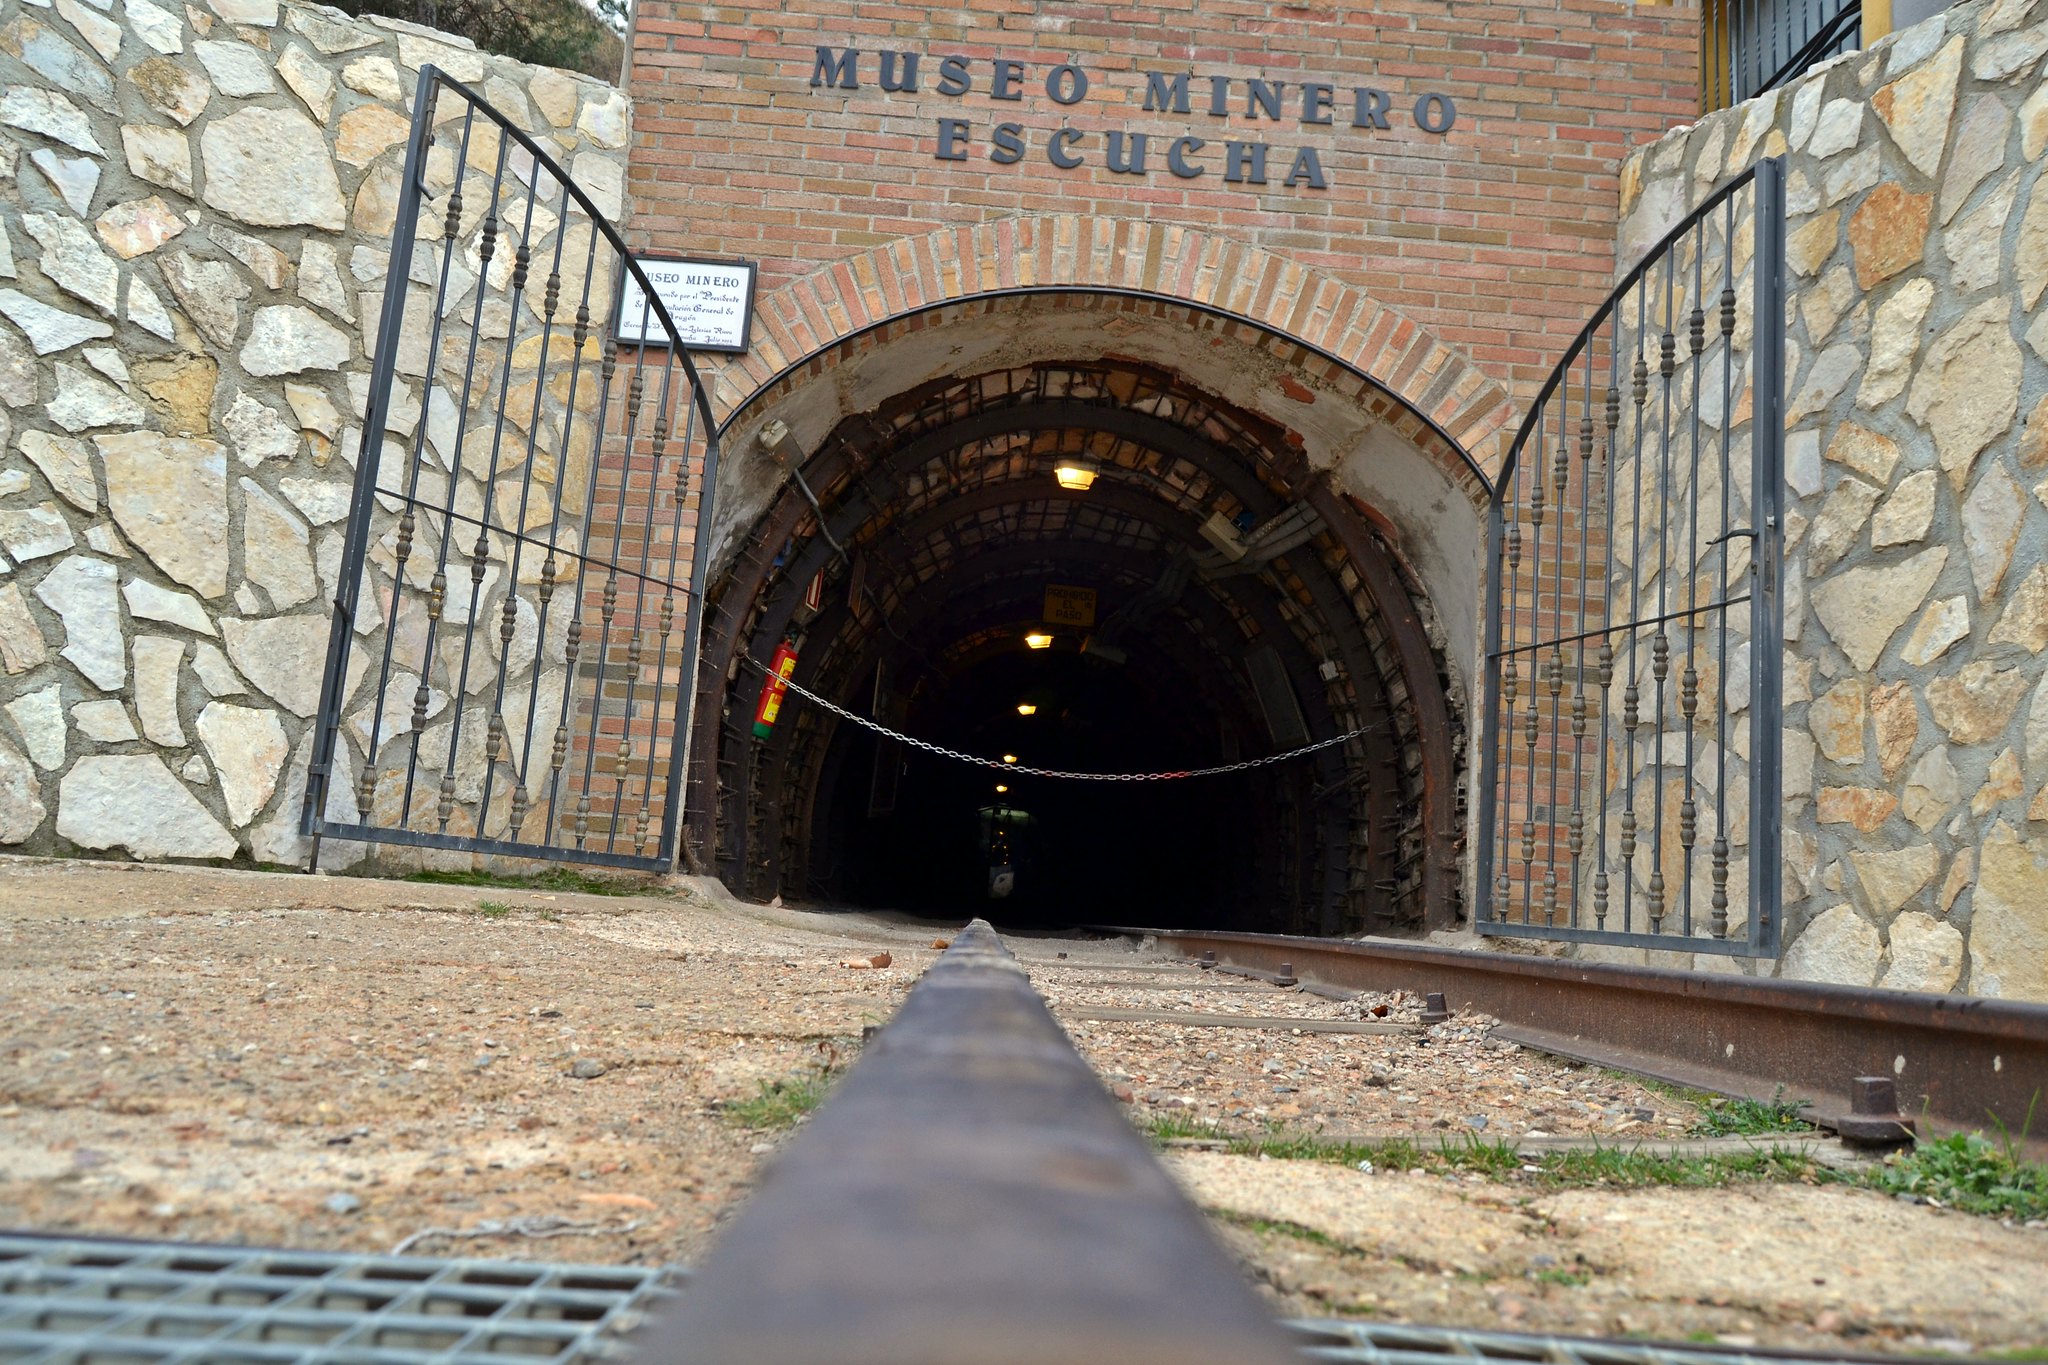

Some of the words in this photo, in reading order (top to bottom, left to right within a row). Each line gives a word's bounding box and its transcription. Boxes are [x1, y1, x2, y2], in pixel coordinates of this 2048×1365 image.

[808, 45, 1089, 105] MUSEO
[1142, 70, 1457, 133] MINERO
[935, 118, 1328, 190] ESCUCHA
[642, 271, 680, 284] USEO
[686, 274, 740, 288] MINERO
[699, 290, 740, 303] Presidente
[693, 304, 724, 314] General
[1063, 600, 1076, 610] EL
[1056, 609, 1082, 620] PASO
